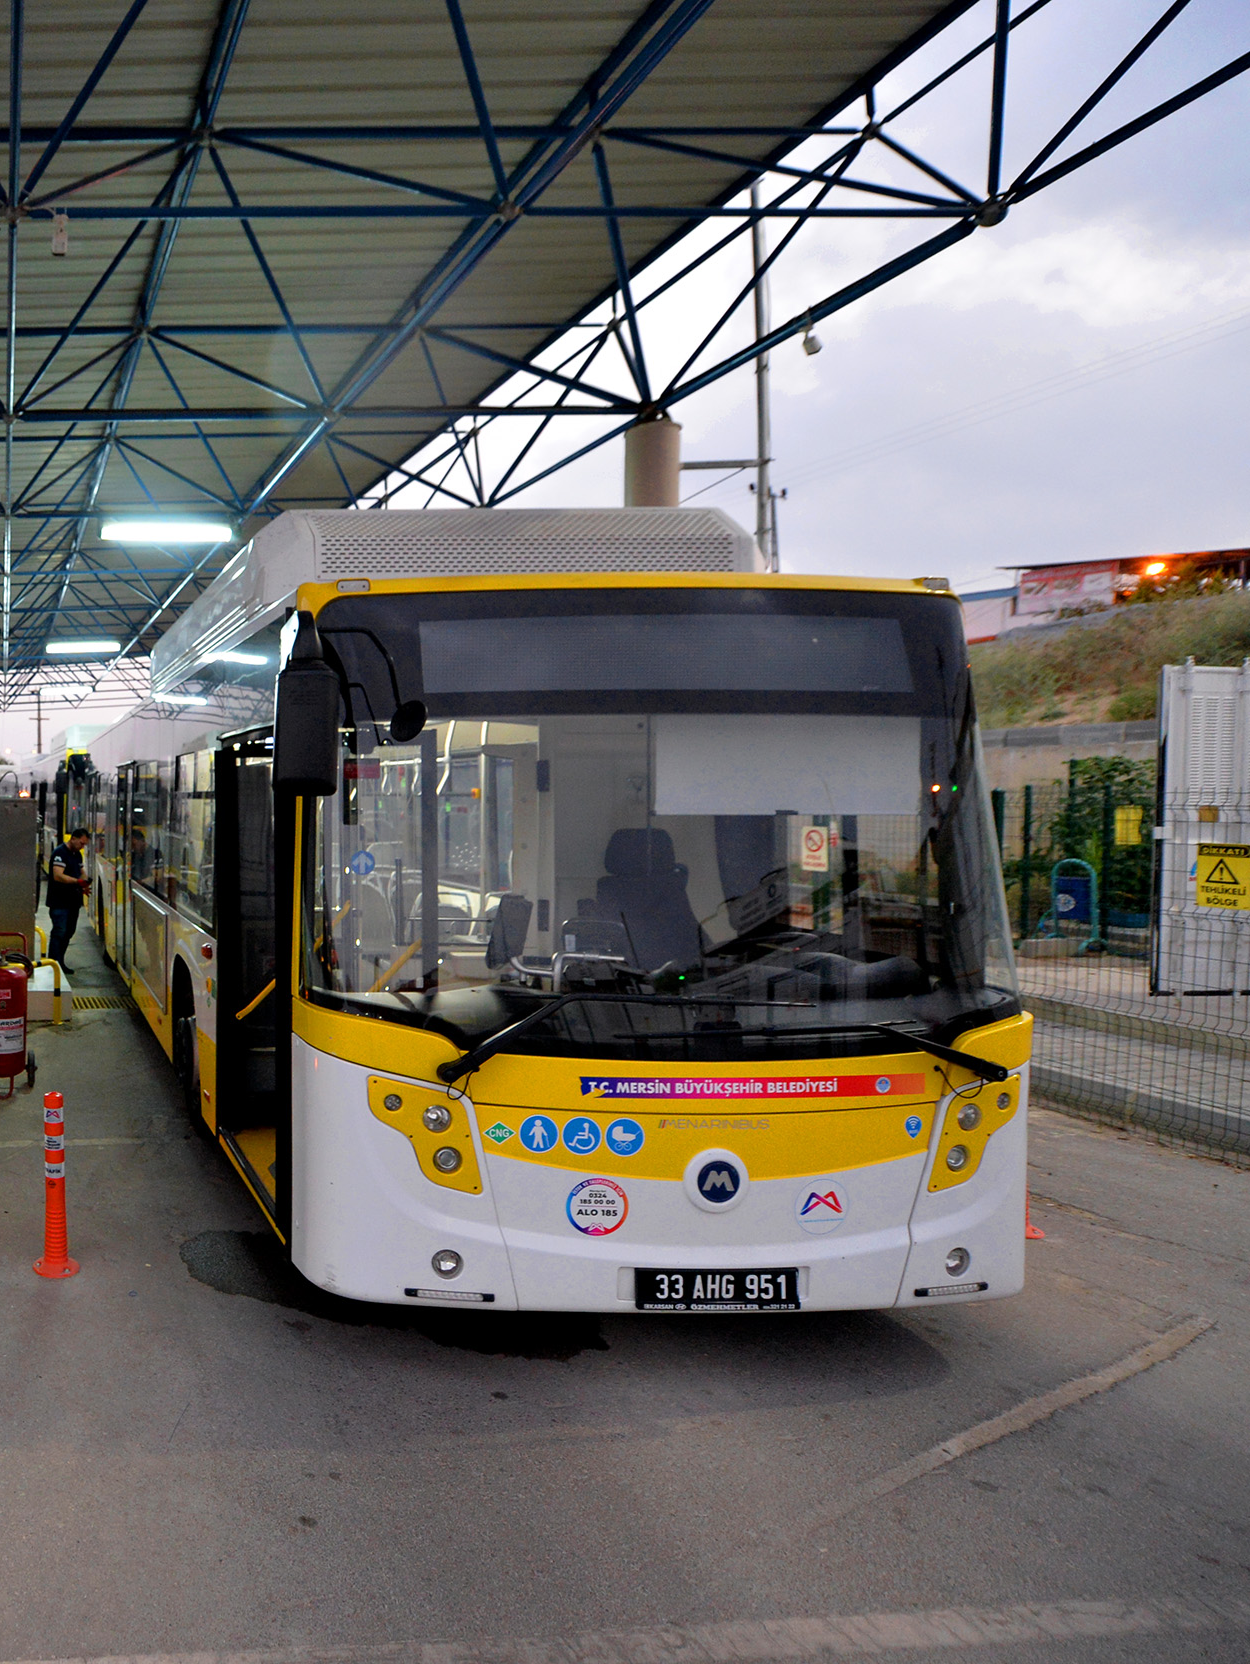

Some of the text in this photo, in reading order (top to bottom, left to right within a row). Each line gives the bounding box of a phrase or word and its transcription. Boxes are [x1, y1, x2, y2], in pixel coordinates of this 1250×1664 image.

[1201, 885, 1247, 896] TEHLİKELİ
[1206, 895, 1239, 906] BÖLGE
[616, 1079, 671, 1094] MERSİN
[675, 1079, 763, 1097] BÜYÜKŞEHİR
[766, 1078, 838, 1094] BELEDİYESİ
[664, 1119, 770, 1130] MENARINIBUS
[489, 1128, 510, 1138] CNG
[701, 1170, 736, 1192] M
[601, 1209, 618, 1217] 185
[655, 1274, 787, 1299] 33 AHG 951
